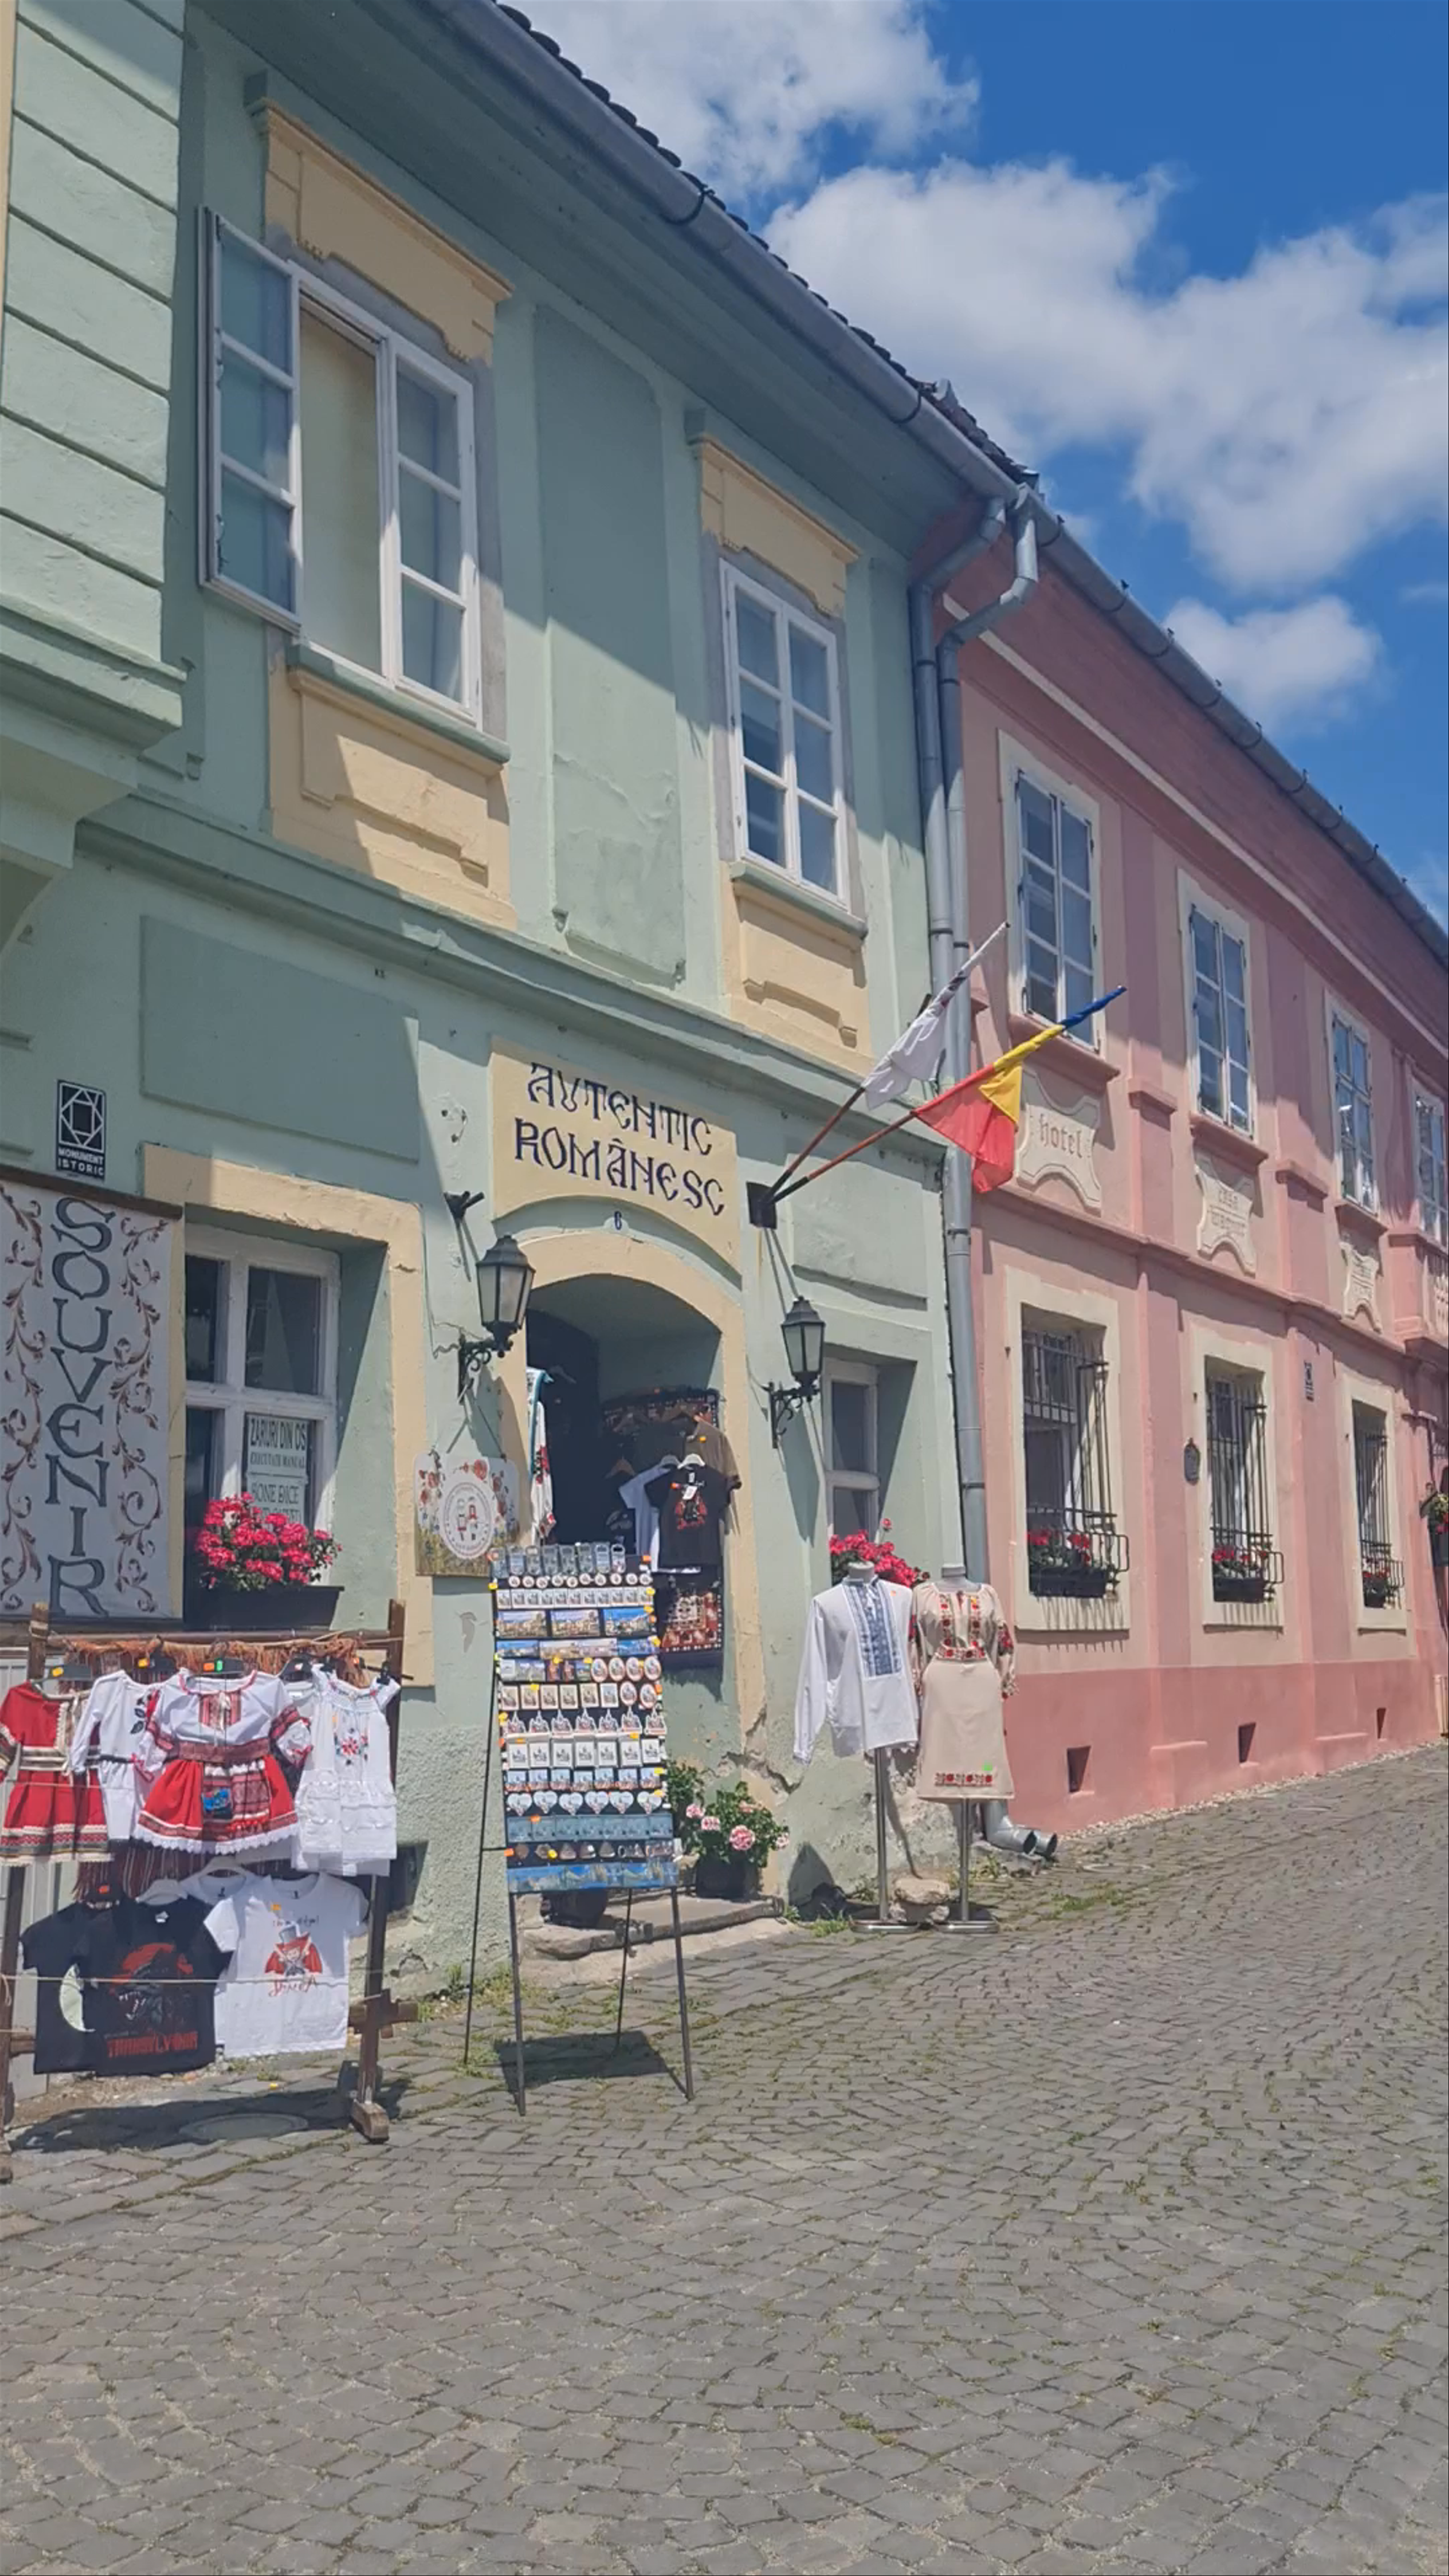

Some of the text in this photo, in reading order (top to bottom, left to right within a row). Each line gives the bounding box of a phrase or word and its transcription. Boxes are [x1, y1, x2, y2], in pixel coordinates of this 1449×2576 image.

[1039, 1113, 1082, 1159] hotel
[58, 1146, 104, 1165] MONUMENT
[58, 1157, 104, 1177] ISTORIC
[45, 1196, 116, 1617] SOUVENIR
[280, 1420, 293, 1450] DIN
[294, 1423, 306, 1451] OS
